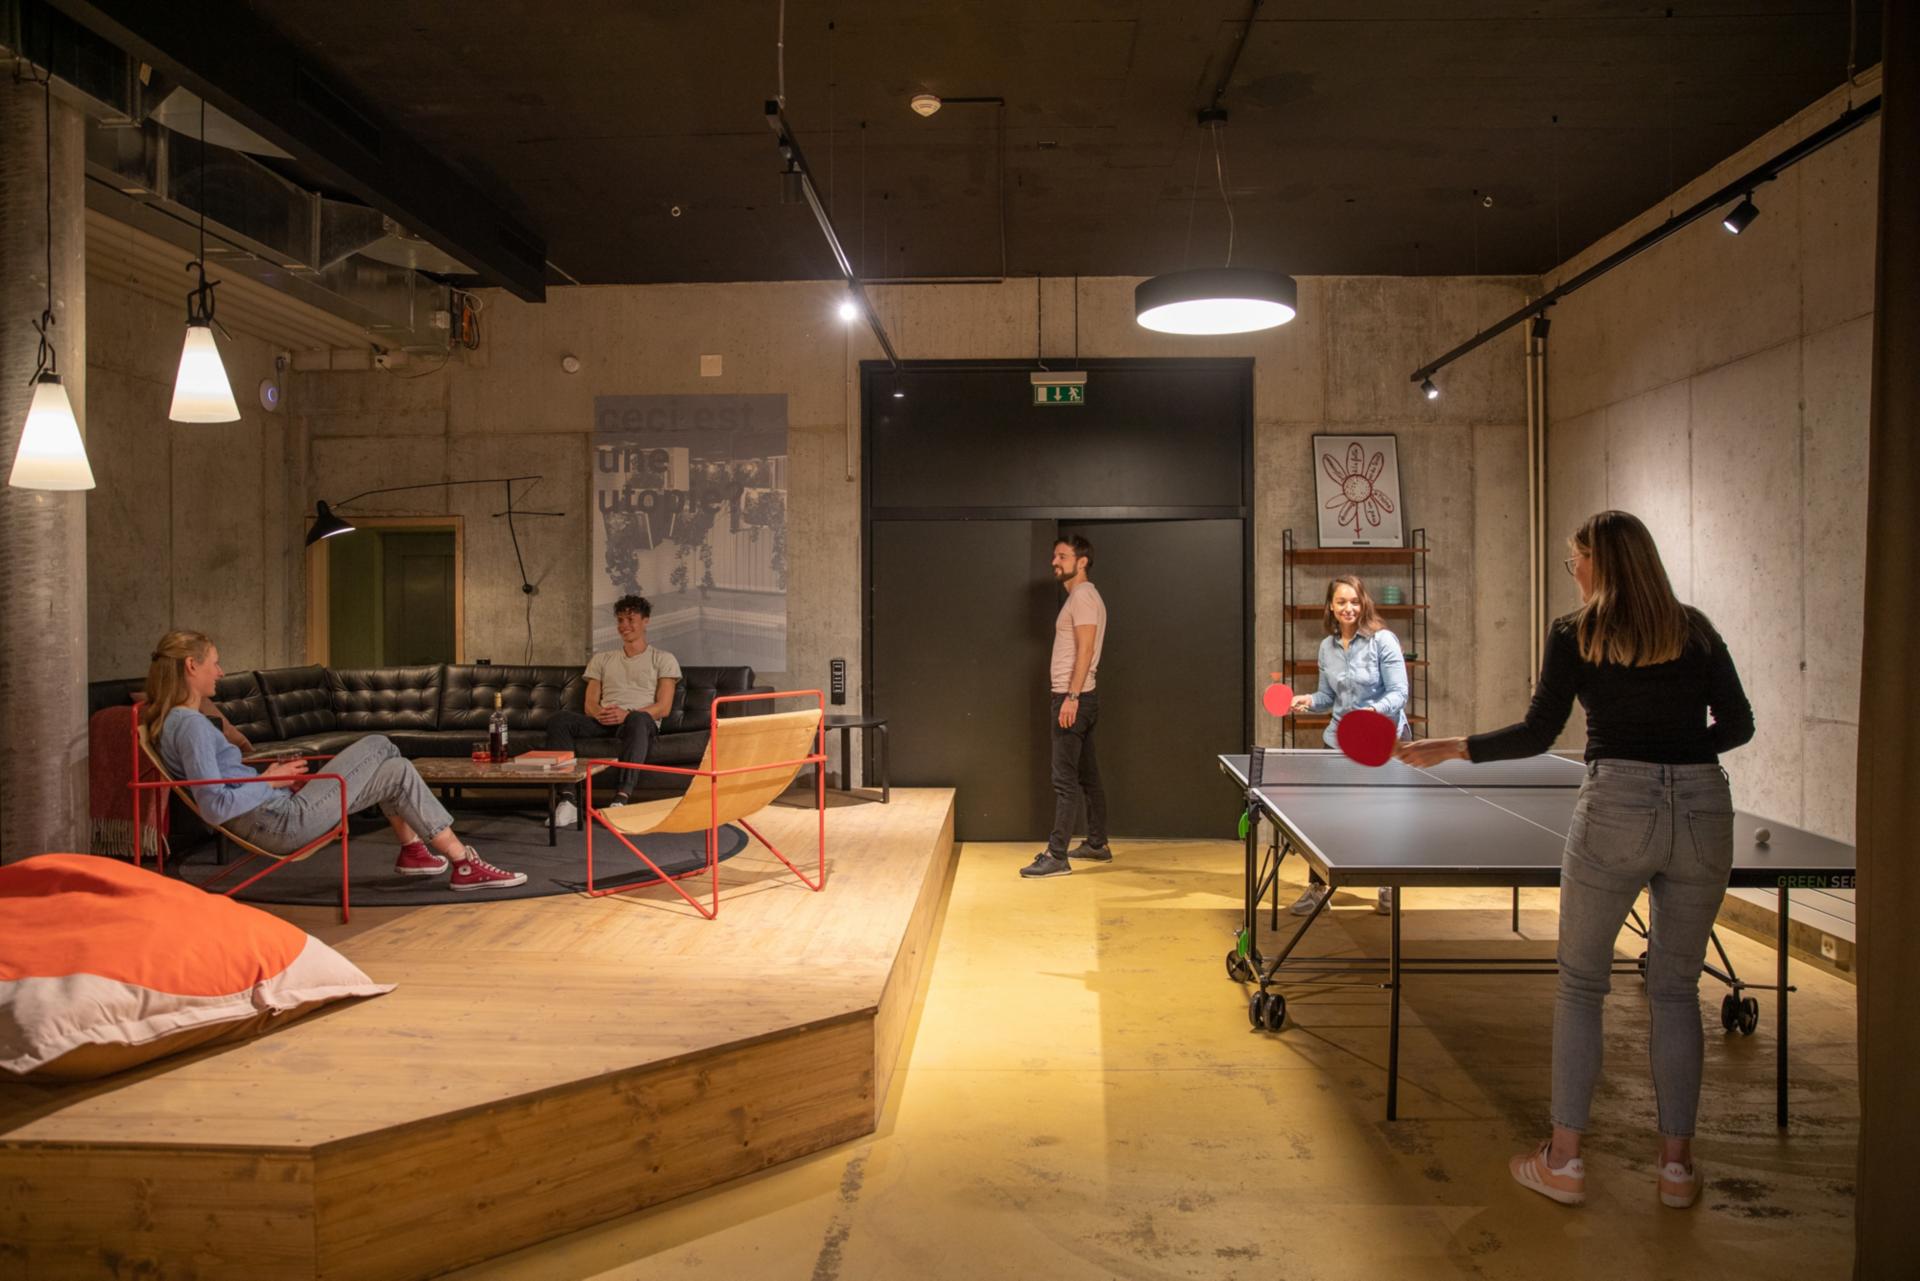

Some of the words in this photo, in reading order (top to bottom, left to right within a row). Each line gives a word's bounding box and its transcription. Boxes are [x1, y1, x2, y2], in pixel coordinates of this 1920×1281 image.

[599, 398, 679, 433] ceci
[693, 401, 755, 433] est
[599, 448, 670, 474] une
[1777, 875, 1827, 888] GREEN
